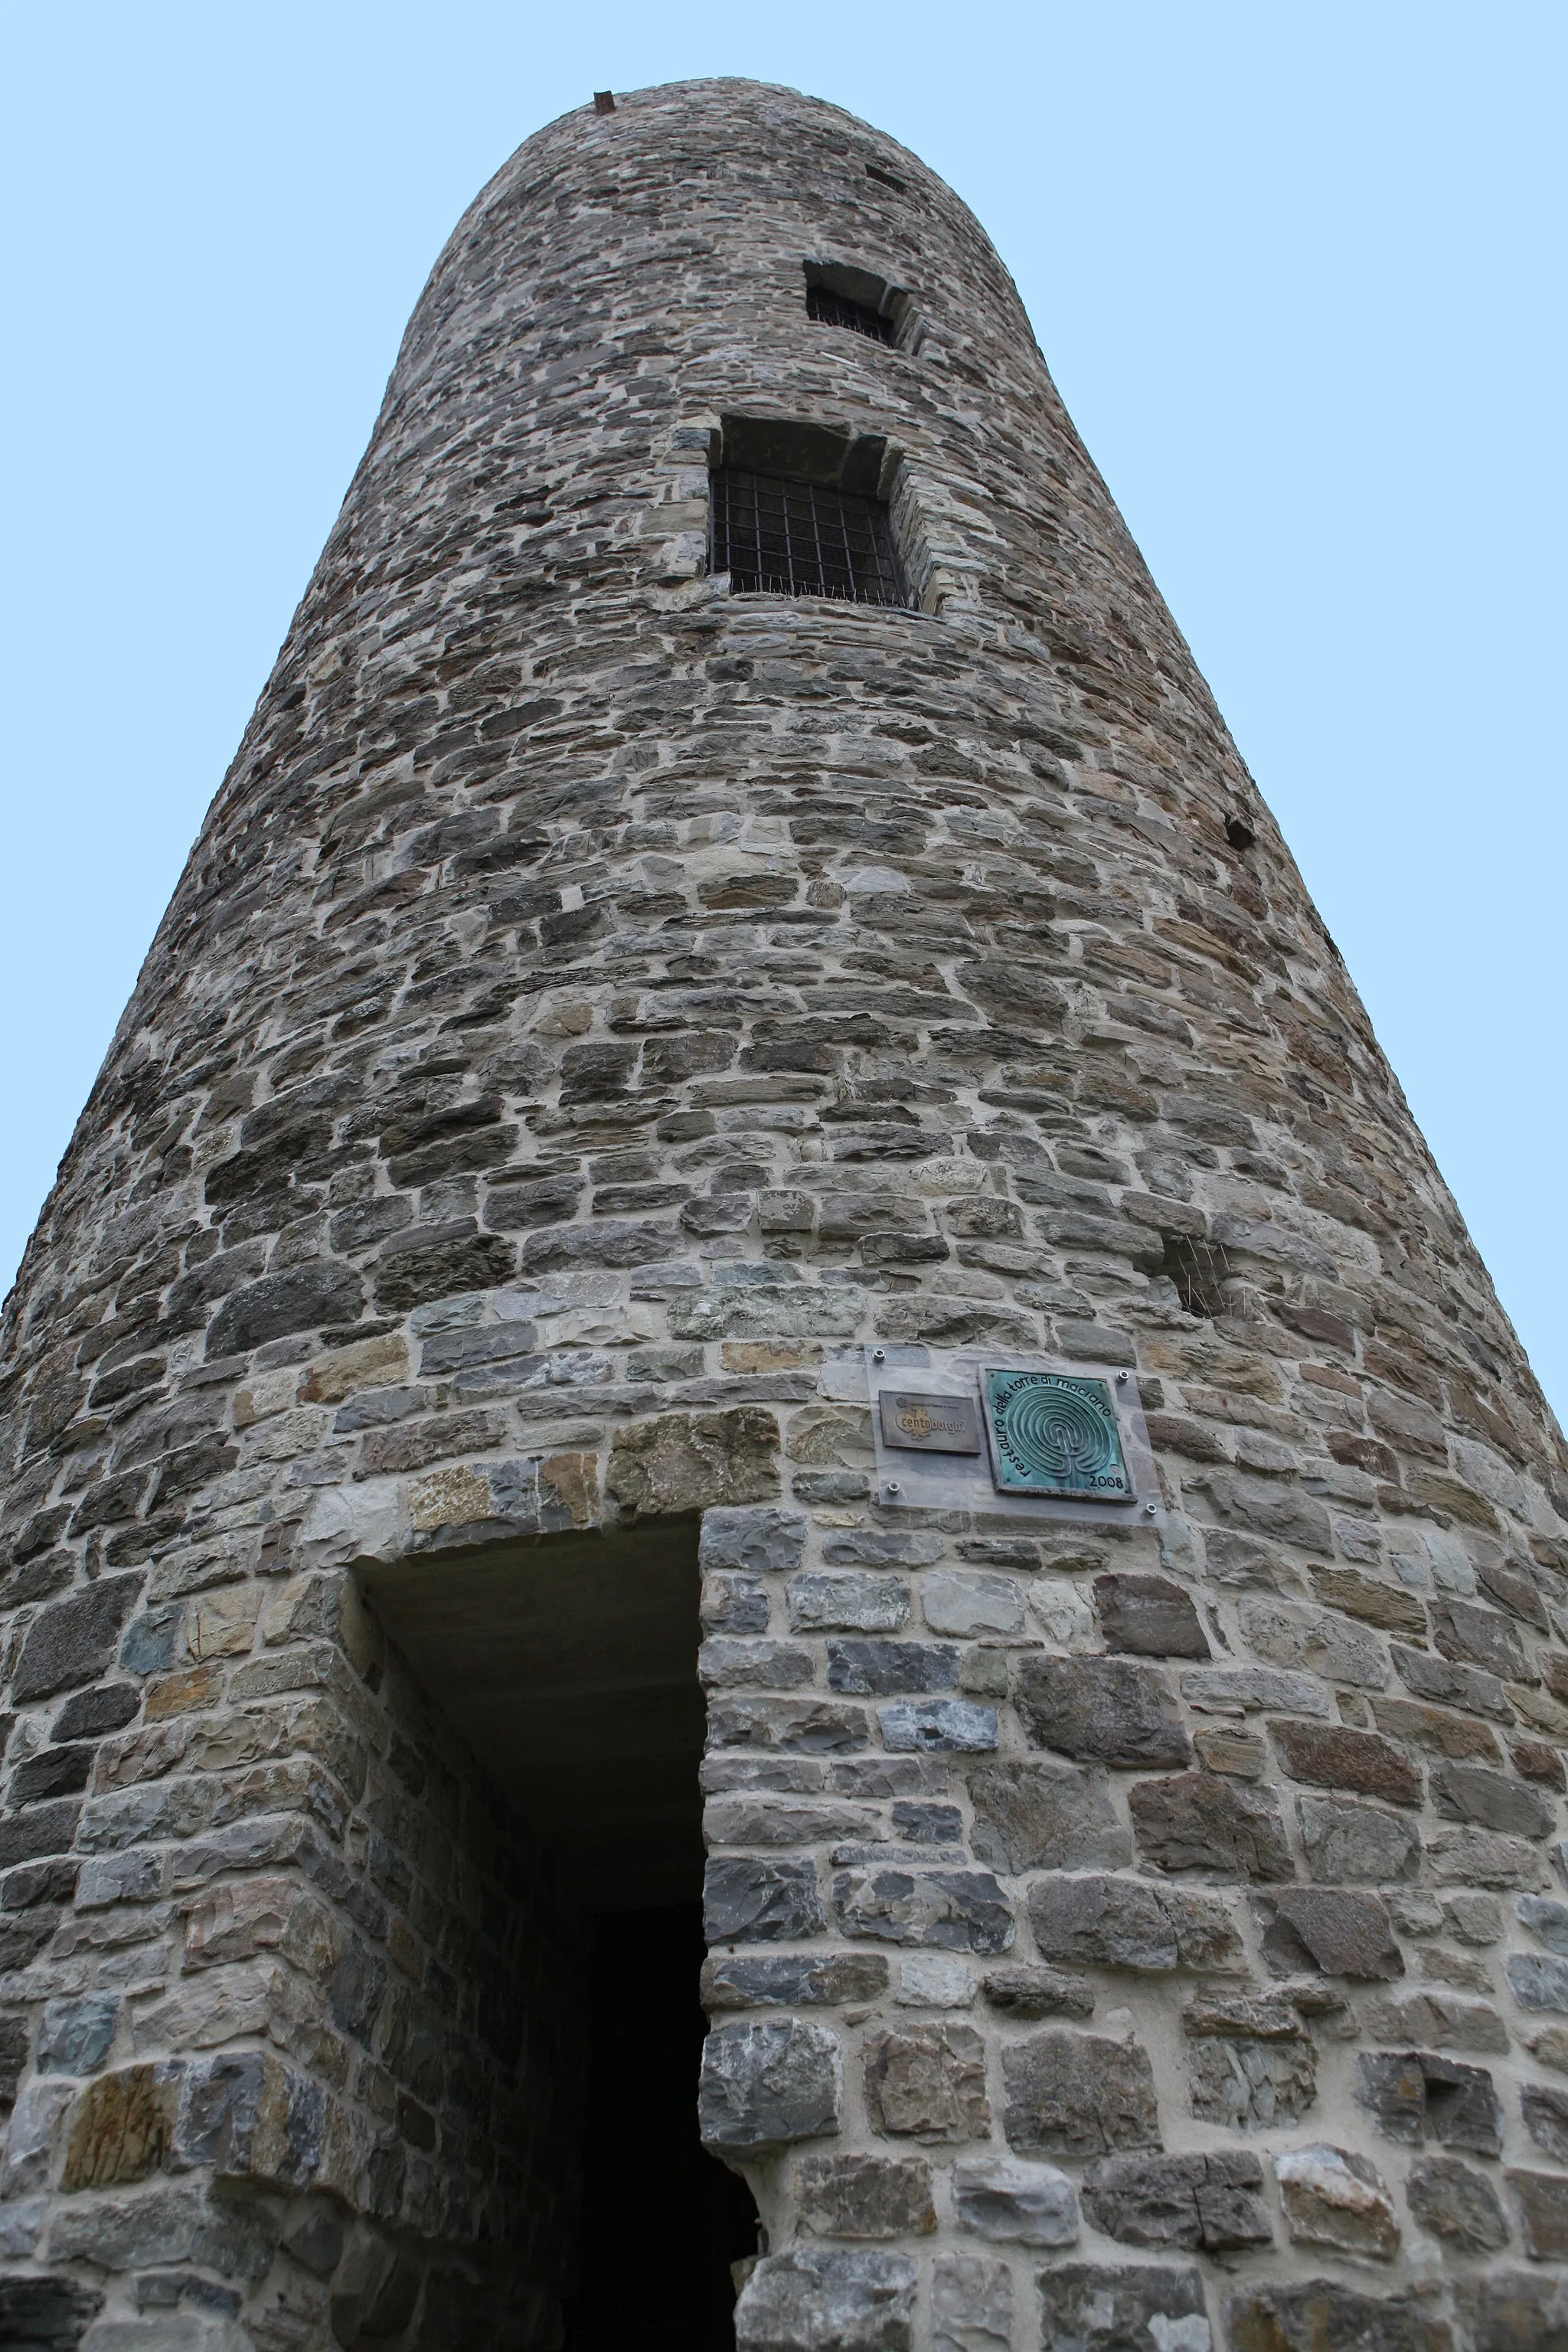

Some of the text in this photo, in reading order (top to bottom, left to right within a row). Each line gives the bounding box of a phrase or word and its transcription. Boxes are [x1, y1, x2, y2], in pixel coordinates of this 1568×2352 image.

[992, 1375, 1111, 1478] restauro della torre di maciano
[1089, 1476, 1124, 1489] 2008
